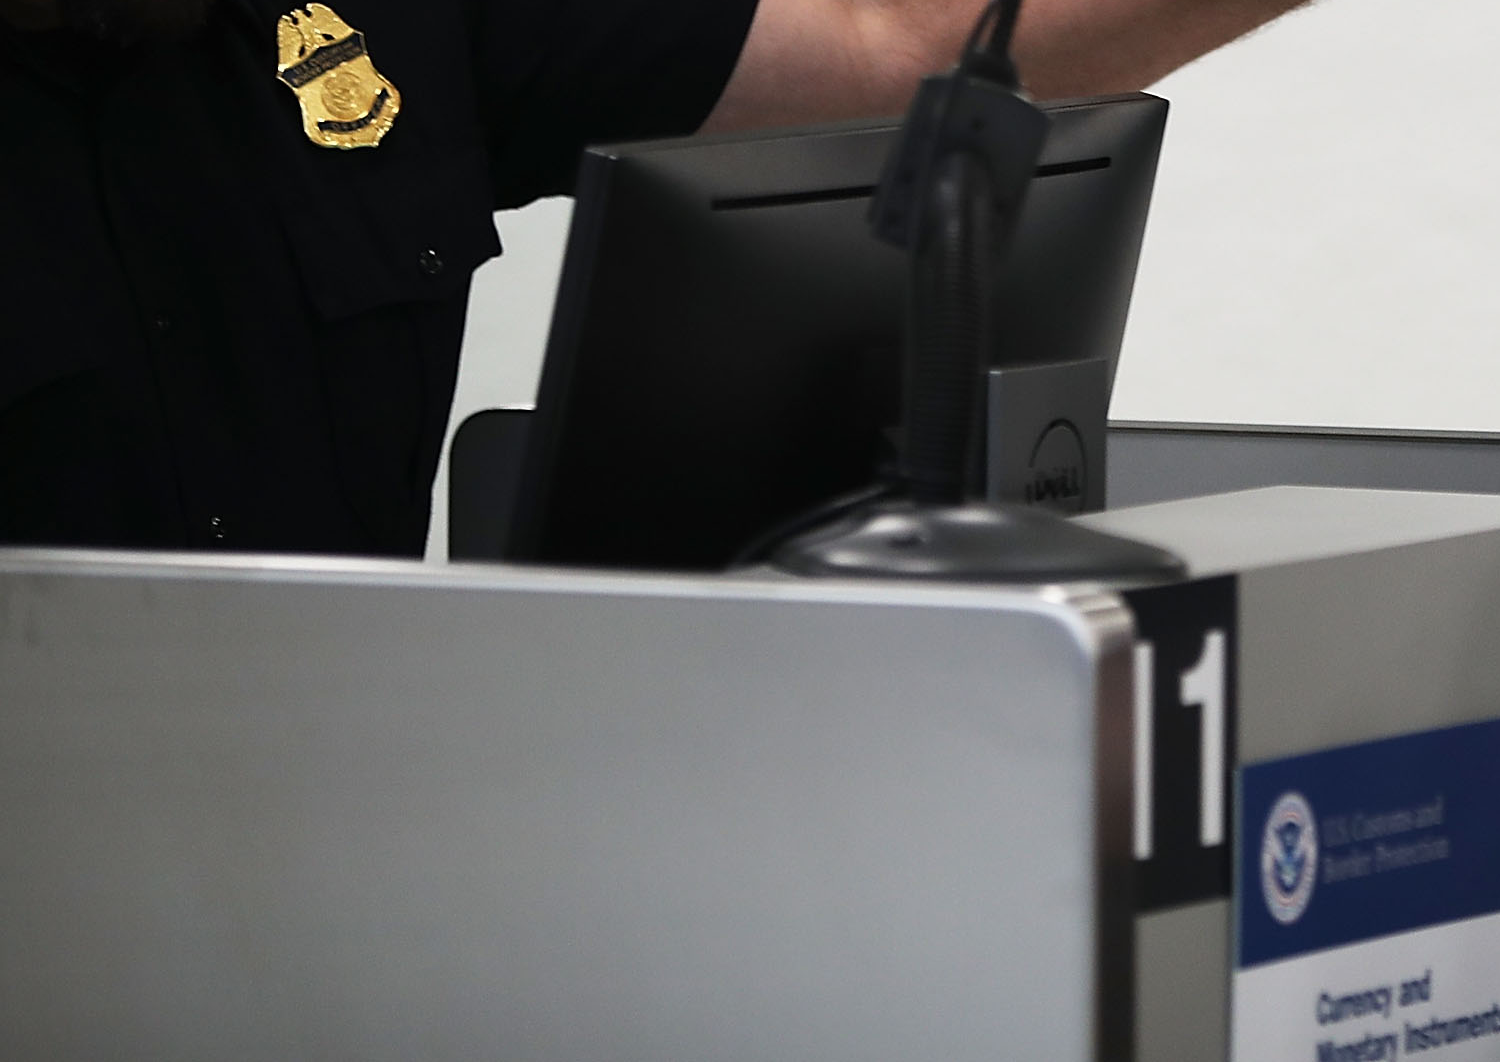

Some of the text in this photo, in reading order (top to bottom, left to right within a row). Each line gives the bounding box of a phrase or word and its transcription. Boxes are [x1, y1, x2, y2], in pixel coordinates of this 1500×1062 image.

[1416, 794, 1443, 827] and
[1315, 969, 1433, 1026] Currency and
[1314, 1033, 1397, 1062] Monetary
